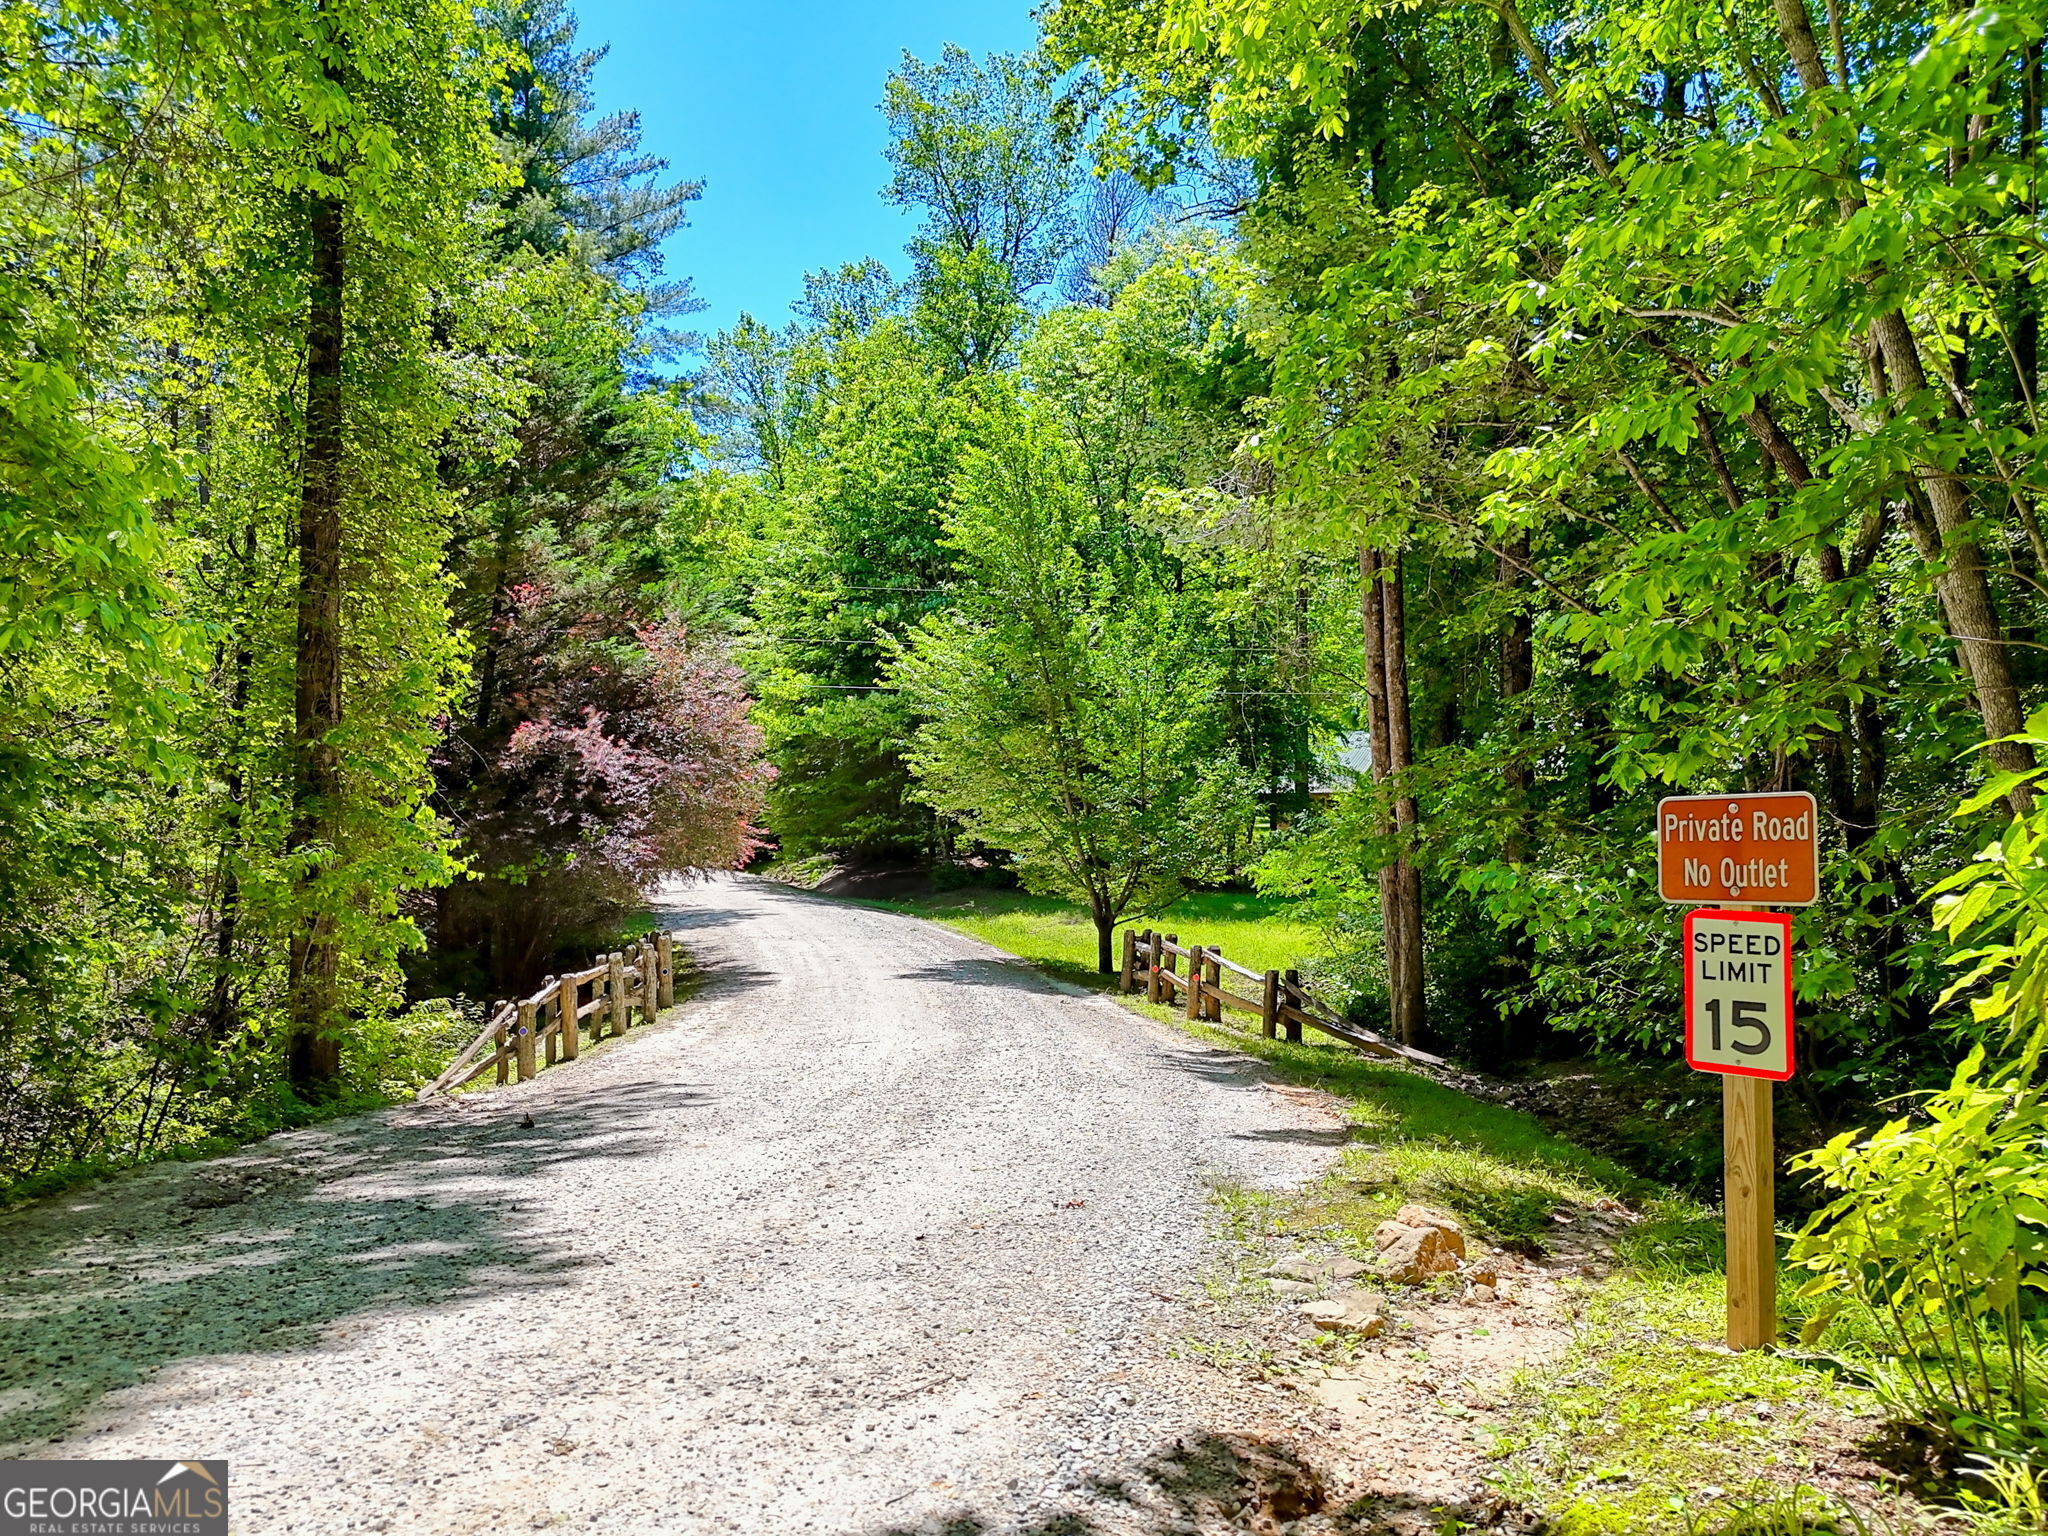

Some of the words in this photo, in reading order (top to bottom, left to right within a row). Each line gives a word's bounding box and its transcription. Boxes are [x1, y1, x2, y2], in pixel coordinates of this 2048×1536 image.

[1665, 813, 1743, 842] Private
[1753, 810, 1809, 841] Road
[1684, 858, 1710, 887] No
[1720, 857, 1789, 888] Outlet
[1694, 932, 1780, 956] SPEED
[1702, 960, 1772, 983] LIMIT
[1705, 999, 1771, 1055] 15
